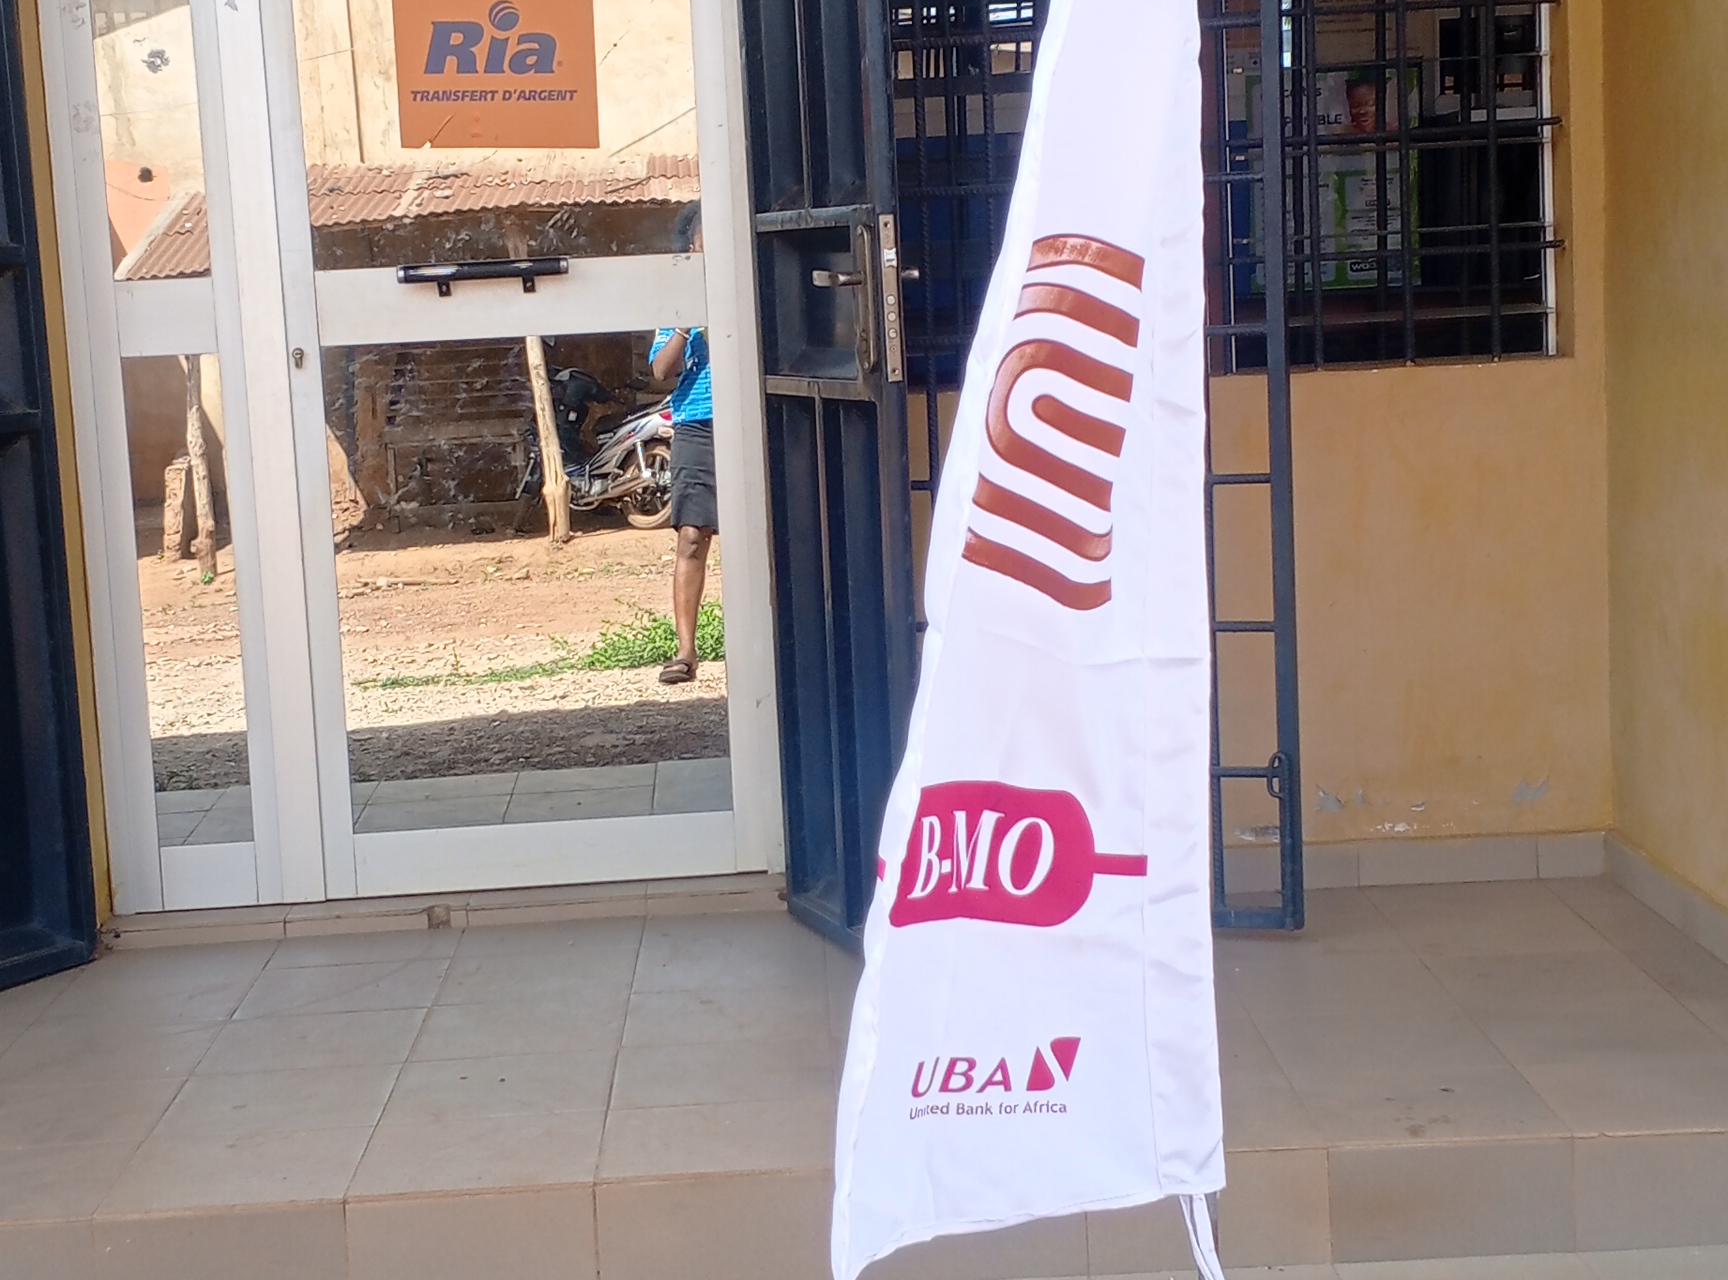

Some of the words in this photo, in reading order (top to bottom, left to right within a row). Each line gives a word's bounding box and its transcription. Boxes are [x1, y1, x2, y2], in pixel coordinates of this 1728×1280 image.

[424, 0, 557, 75] Ria
[411, 90, 499, 102] TRANSFERT
[502, 89, 578, 102] D'ARGENT
[907, 809, 1055, 900] B-MO
[911, 1056, 1012, 1098] UBA
[909, 1102, 950, 1120] United
[956, 1102, 993, 1115] Bank
[999, 1102, 1019, 1114] for
[1023, 1100, 1067, 1114] Africa
